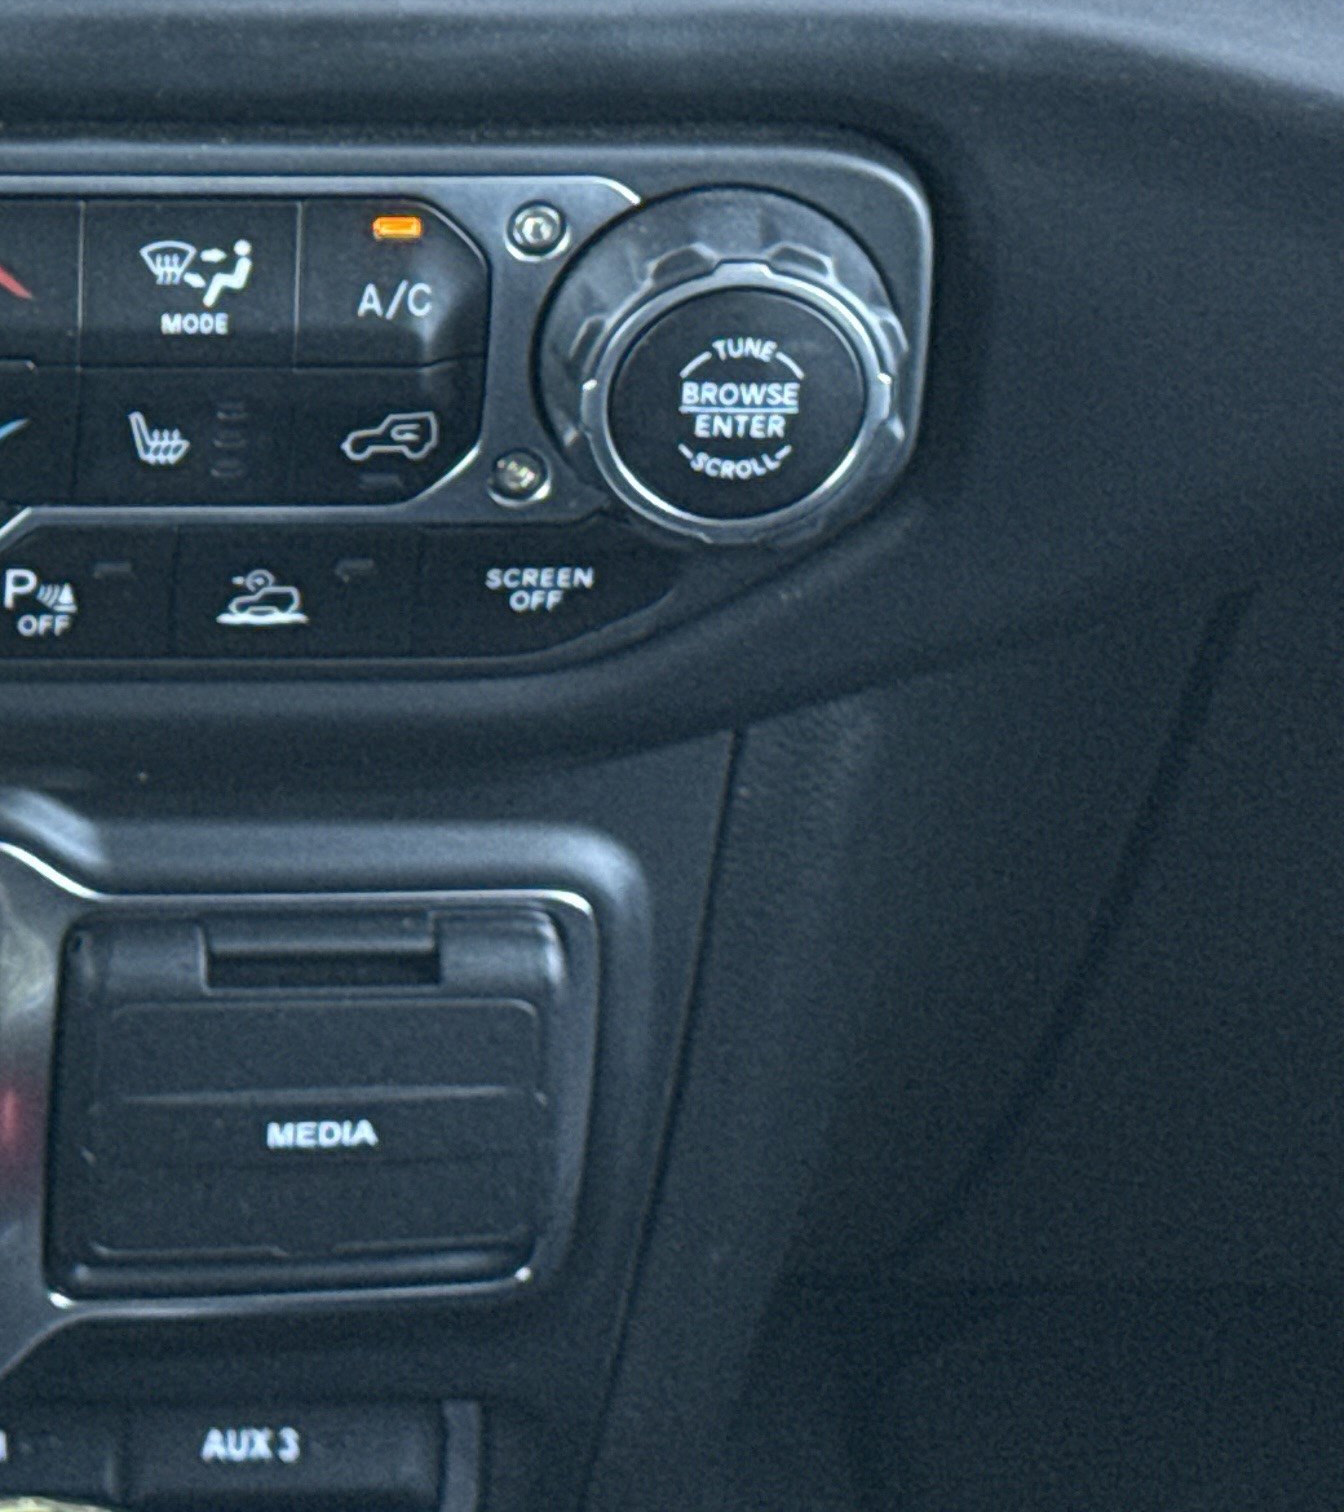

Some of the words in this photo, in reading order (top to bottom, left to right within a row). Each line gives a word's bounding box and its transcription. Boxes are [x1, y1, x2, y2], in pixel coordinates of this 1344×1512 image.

[356, 280, 434, 321] A/C
[160, 311, 229, 336] MODE
[711, 335, 778, 364] TUNE
[680, 381, 800, 406] BROWSE
[694, 410, 790, 440] ENTER
[689, 451, 780, 481] SCROLL
[3, 567, 38, 609] P
[484, 566, 595, 590] SCREEN
[508, 588, 564, 612] OFF
[16, 612, 70, 637] OFF
[265, 1118, 379, 1149] MEDIA
[201, 1428, 273, 1463] AUX
[277, 1426, 300, 1463] 3
